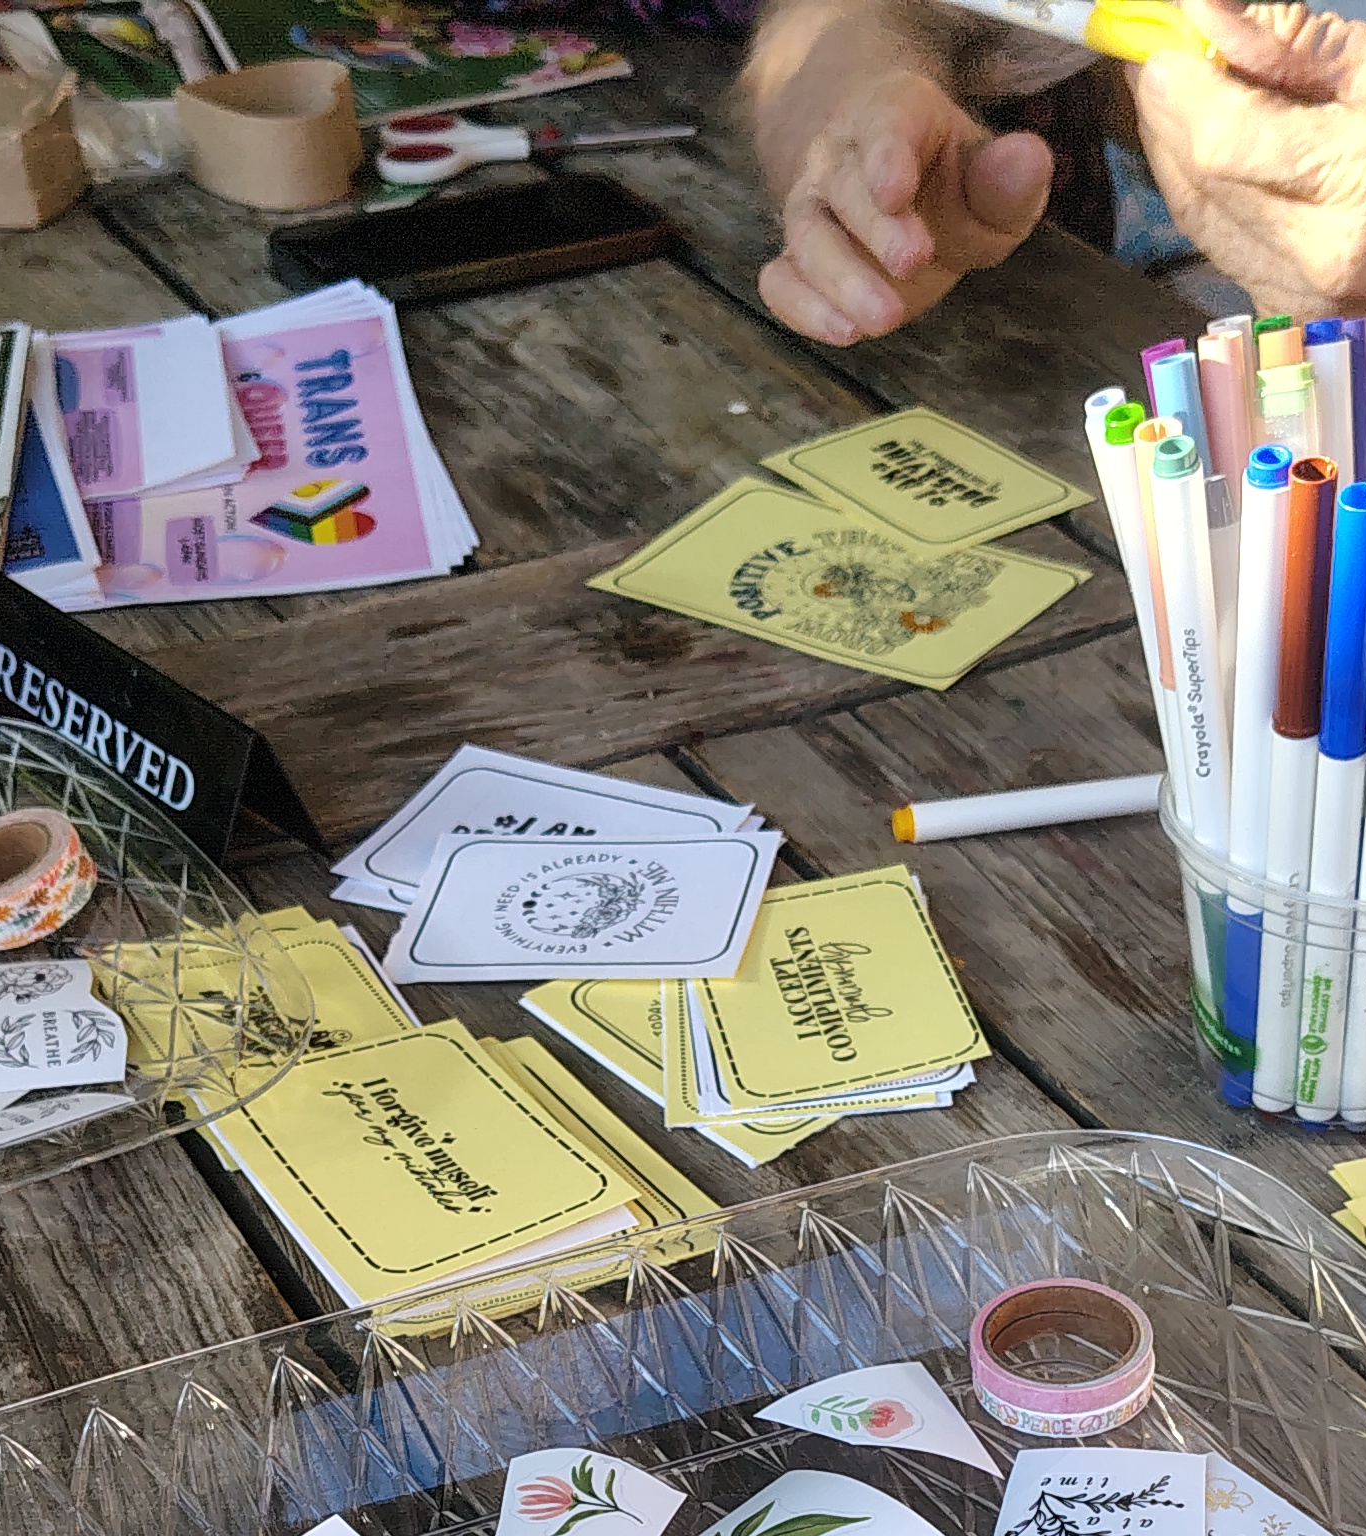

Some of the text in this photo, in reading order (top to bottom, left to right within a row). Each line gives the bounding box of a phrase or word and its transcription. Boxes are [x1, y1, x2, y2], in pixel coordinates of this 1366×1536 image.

[293, 349, 369, 469] TRANS
[729, 540, 813, 621] POSITIVE
[1182, 628, 1206, 703] SuperTips
[521, 871, 539, 884] IS
[540, 852, 624, 875] ALREADY
[493, 884, 521, 913] NEED
[612, 886, 681, 943] WITHIN
[494, 921, 588, 955] EVERYTHING
[769, 956, 823, 1041] I ACCEPT
[784, 925, 858, 1063] COMPLIMENTS
[41, 1010, 63, 1070] BREATHE
[321, 1089, 374, 1123] for
[361, 1076, 499, 1203] I forgive myself
[1020, 1411, 1073, 1436] PEACE
[1105, 1391, 1144, 1425] PEACE
[1040, 1474, 1109, 1490] time
[1085, 1515, 1154, 1531] at a
